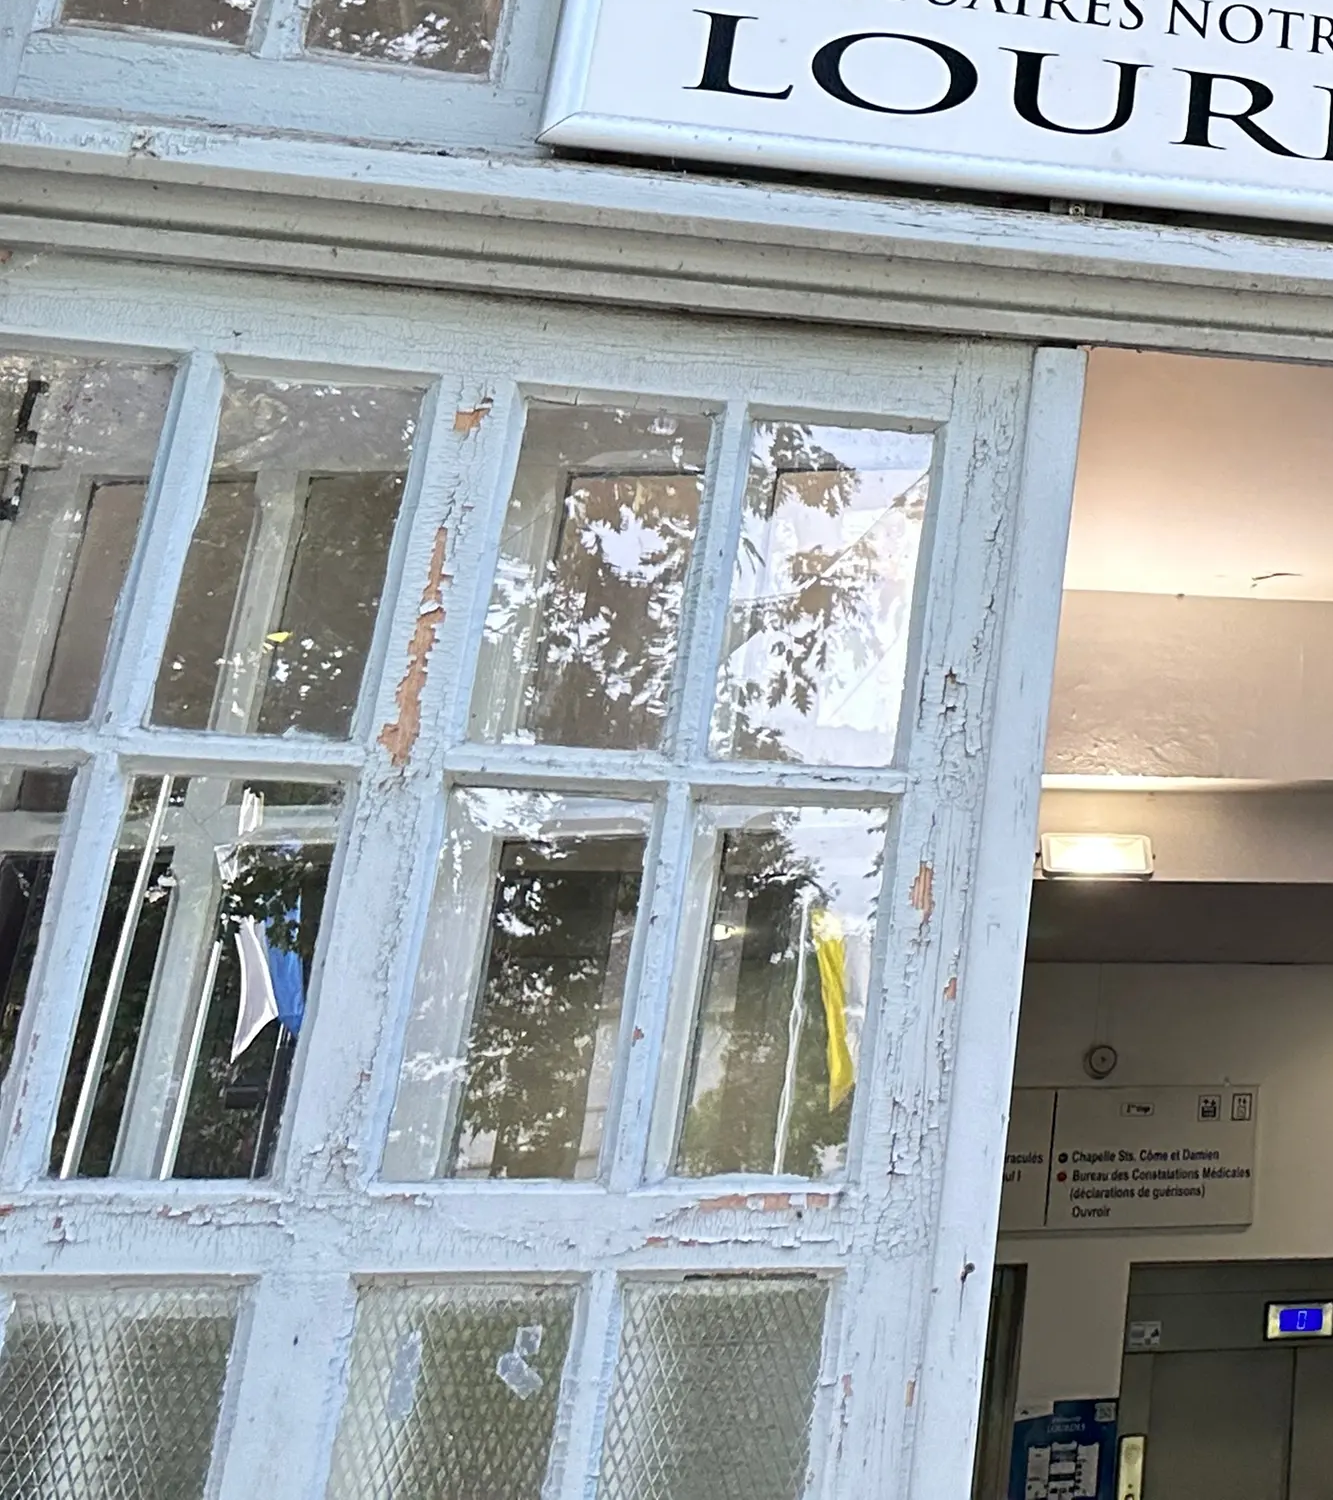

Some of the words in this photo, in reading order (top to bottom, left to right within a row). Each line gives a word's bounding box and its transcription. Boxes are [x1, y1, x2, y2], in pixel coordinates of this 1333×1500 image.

[1005, 1151, 1044, 1165] raculés
[1072, 1150, 1116, 1165] Chapelle
[1118, 1149, 1137, 1162] Sts.
[1139, 1148, 1169, 1162] Côme
[1171, 1149, 1181, 1161] et
[1182, 1148, 1220, 1161] Damien
[1072, 1169, 1108, 1182] Bureau
[1111, 1167, 1130, 1181] des
[1132, 1167, 1200, 1181] Constatations
[1202, 1165, 1251, 1179] Médicales
[1069, 1186, 1135, 1201] (déclarations
[1137, 1186, 1150, 1198] de
[1152, 1182, 1206, 1200] guérisons)
[1072, 1205, 1111, 1218] Ouvroir
